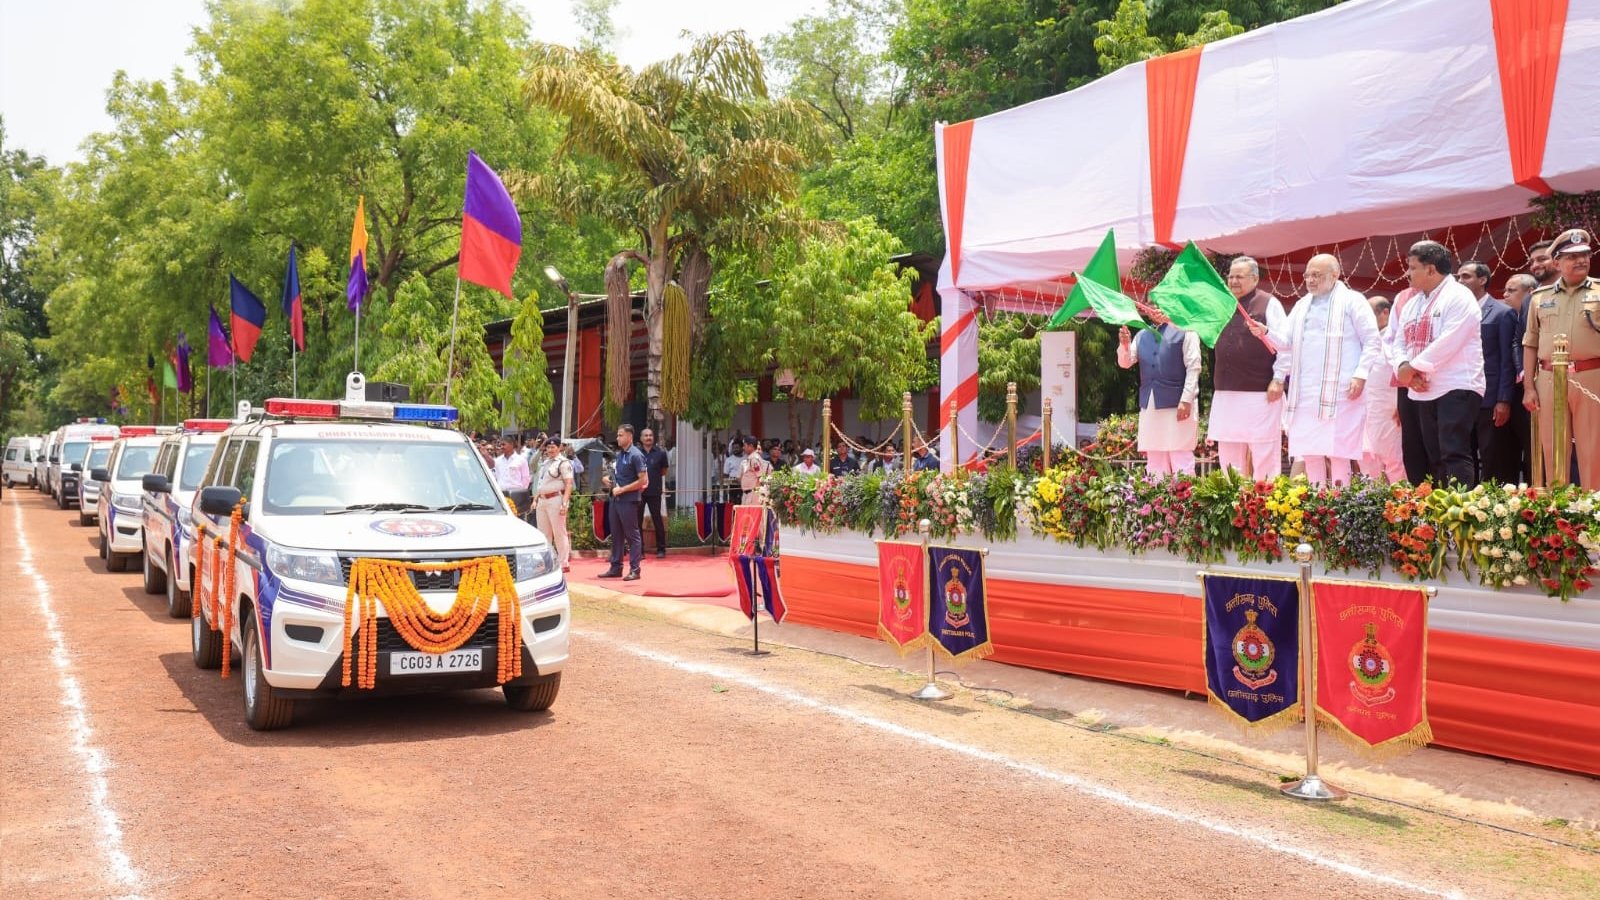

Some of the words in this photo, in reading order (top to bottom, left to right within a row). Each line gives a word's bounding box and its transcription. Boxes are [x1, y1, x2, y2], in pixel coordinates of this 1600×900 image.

[400, 656, 432, 670] CG03
[436, 655, 443, 668] A
[449, 654, 480, 668] 2726
